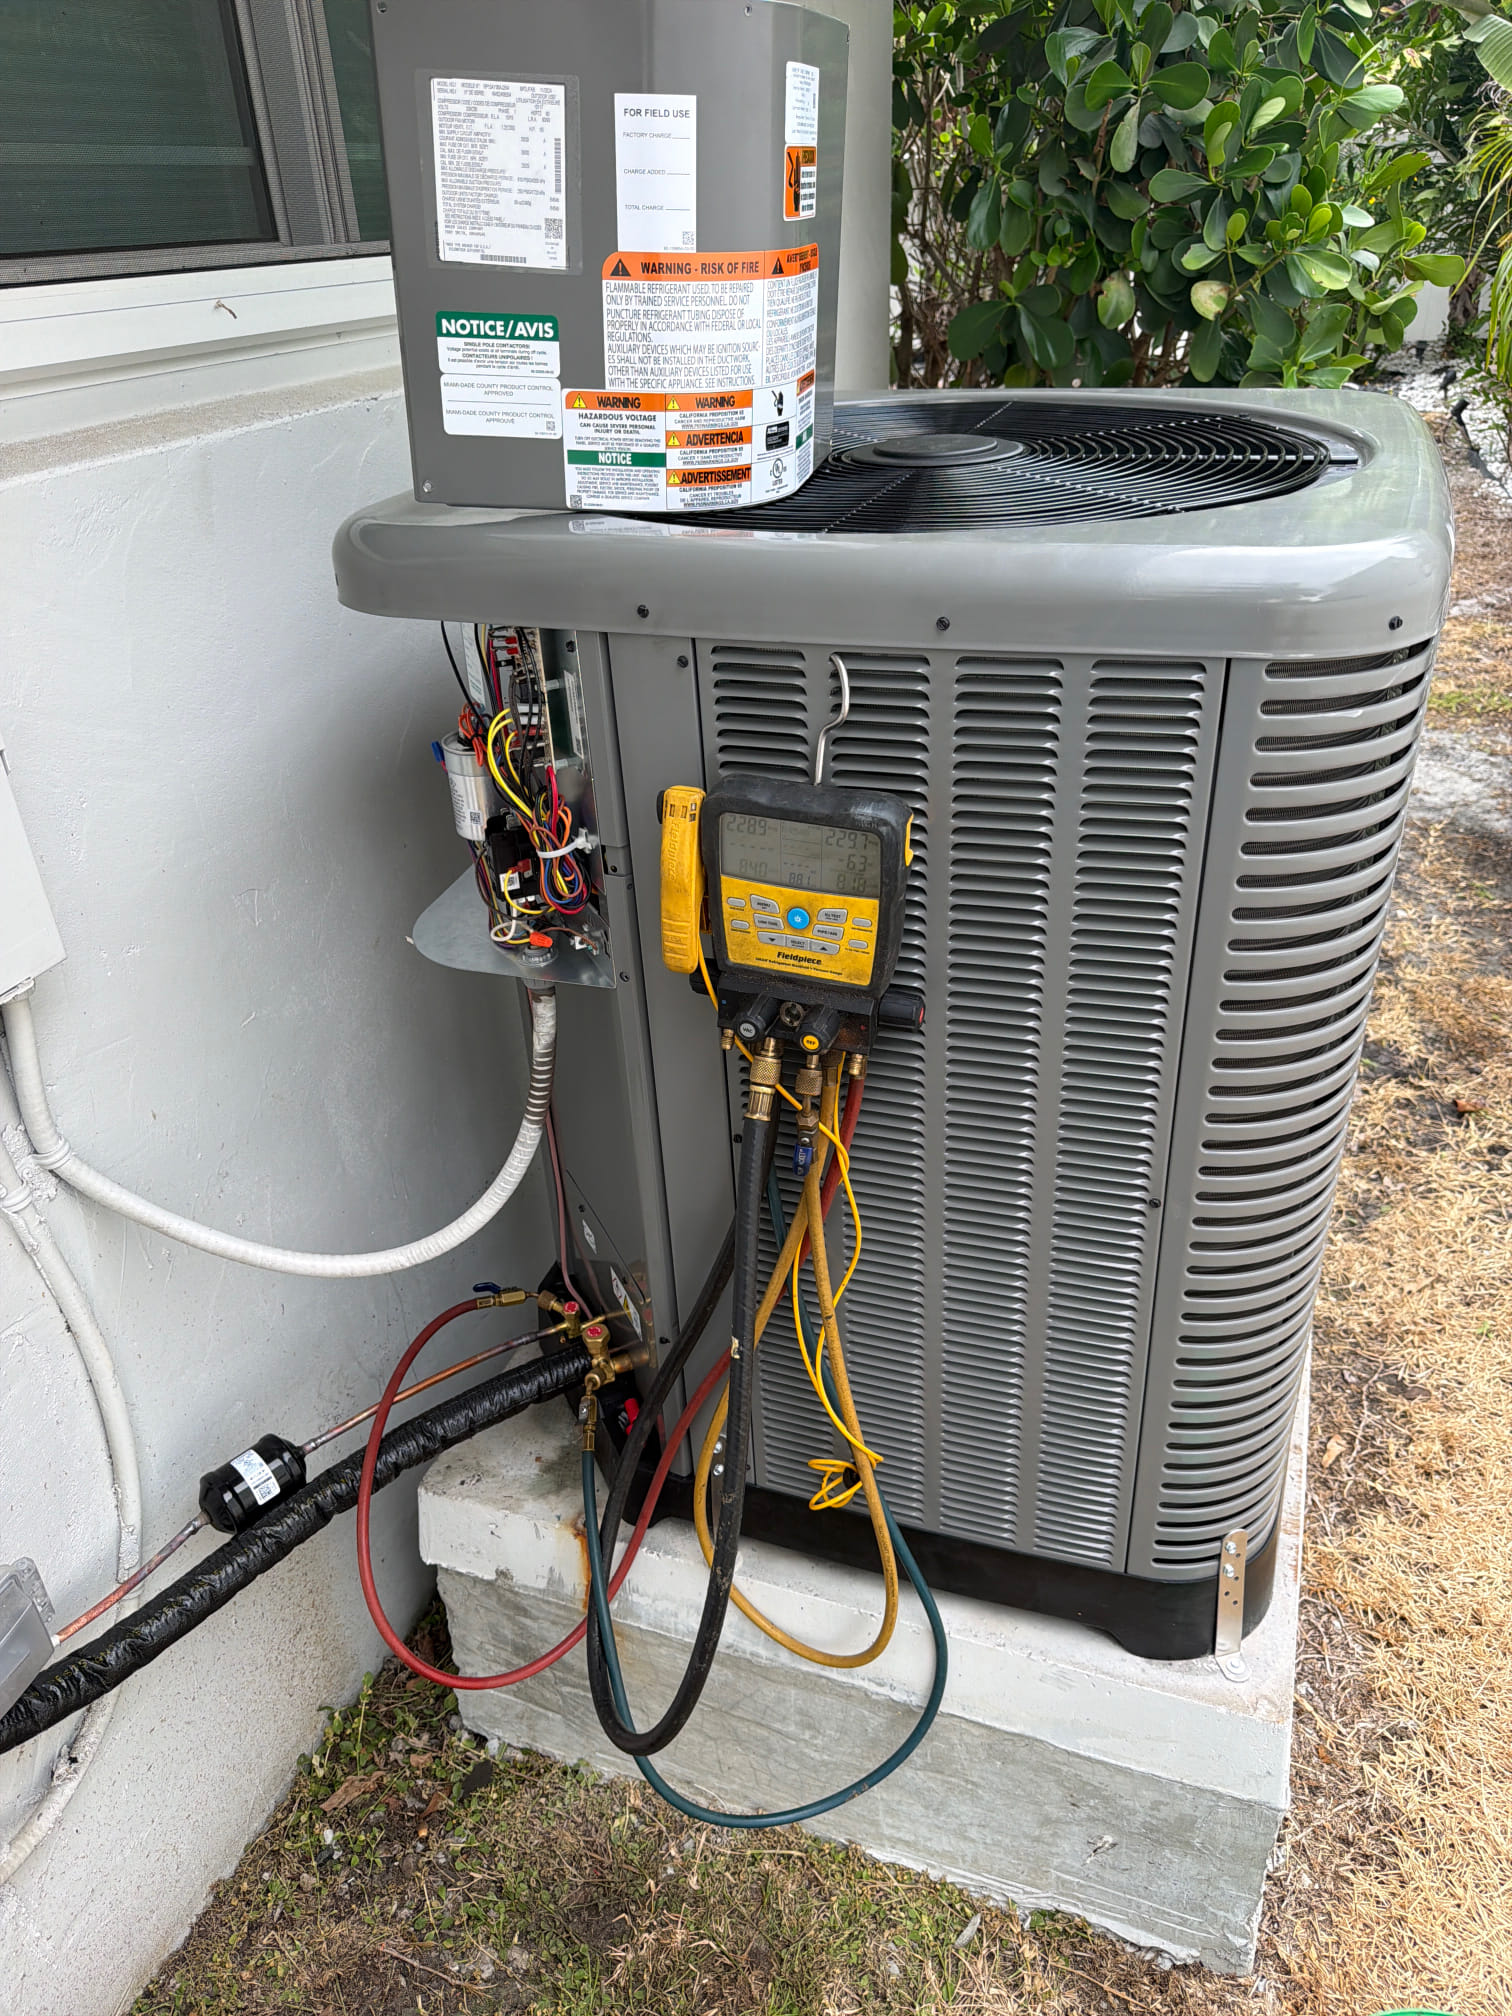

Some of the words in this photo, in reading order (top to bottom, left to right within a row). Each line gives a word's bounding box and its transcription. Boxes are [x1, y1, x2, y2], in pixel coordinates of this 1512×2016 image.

[624, 109, 642, 117] FOR
[645, 109, 670, 117] FIELD
[673, 110, 690, 118] USE
[641, 262, 691, 274] WARNING
[701, 263, 725, 274] RISK
[727, 262, 738, 273] OF
[742, 262, 759, 273] FIRE
[606, 282, 646, 293] FLAMMABLE
[647, 283, 690, 294] REFRIGERANT
[711, 284, 719, 293] TO
[721, 283, 728, 293] BE
[729, 283, 753, 293] REPAIRED
[606, 295, 623, 305] ONLY
[625, 295, 633, 306] BY
[634, 295, 662, 306] TRAINED
[664, 295, 689, 306] SERVICE
[729, 295, 737, 306] DO
[739, 295, 750, 305] NOT
[607, 309, 641, 319] PUNCTURE
[643, 309, 686, 320] REFRIGERANT
[712, 309, 736, 319] DISPOSE
[737, 308, 744, 318] OF
[442, 318, 554, 338] NOTICE/AVIS
[607, 320, 638, 331] PROPERLY
[640, 321, 647, 331] IN
[649, 321, 692, 331] ACCORDANCE
[694, 321, 710, 331] WITH
[711, 320, 736, 331] FEDERAL
[738, 320, 745, 329] OR
[746, 319, 761, 329] LOCAL
[607, 332, 654, 343] REGULATIONS.
[608, 344, 640, 354] AUXILIARY
[642, 344, 668, 355] DEVICES
[670, 345, 691, 355] WHICH
[693, 344, 706, 355] MAY
[708, 344, 715, 354] BE
[716, 343, 740, 354] IGNITION
[608, 356, 615, 364] ES
[617, 356, 637, 364] SHALL
[638, 356, 652, 365] NOT
[654, 356, 661, 365] BE
[663, 356, 696, 365] INSTALLED
[698, 356, 703, 364] IN
[705, 356, 716, 364] THE
[608, 366, 629, 376] OTHER
[630, 366, 648, 376] THAN
[650, 367, 682, 377] AUXILIARY
[684, 367, 709, 377] DEVICES
[711, 366, 729, 376] LISTED
[731, 365, 741, 375] FOR
[743, 364, 751, 374] USE
[608, 378, 625, 388] WITH
[626, 378, 638, 388] THE
[640, 378, 666, 388] SPECIFIC
[705, 378, 715, 388] SEE
[597, 396, 641, 409] WARNING
[695, 395, 735, 408] WARNING
[578, 412, 623, 421] HAZARDOUS
[686, 431, 743, 446] ADVERTENCIA
[598, 453, 632, 464] NOTICE
[680, 467, 751, 484] ADVERTISSEMENT
[777, 951, 823, 966] Fieldpiece
